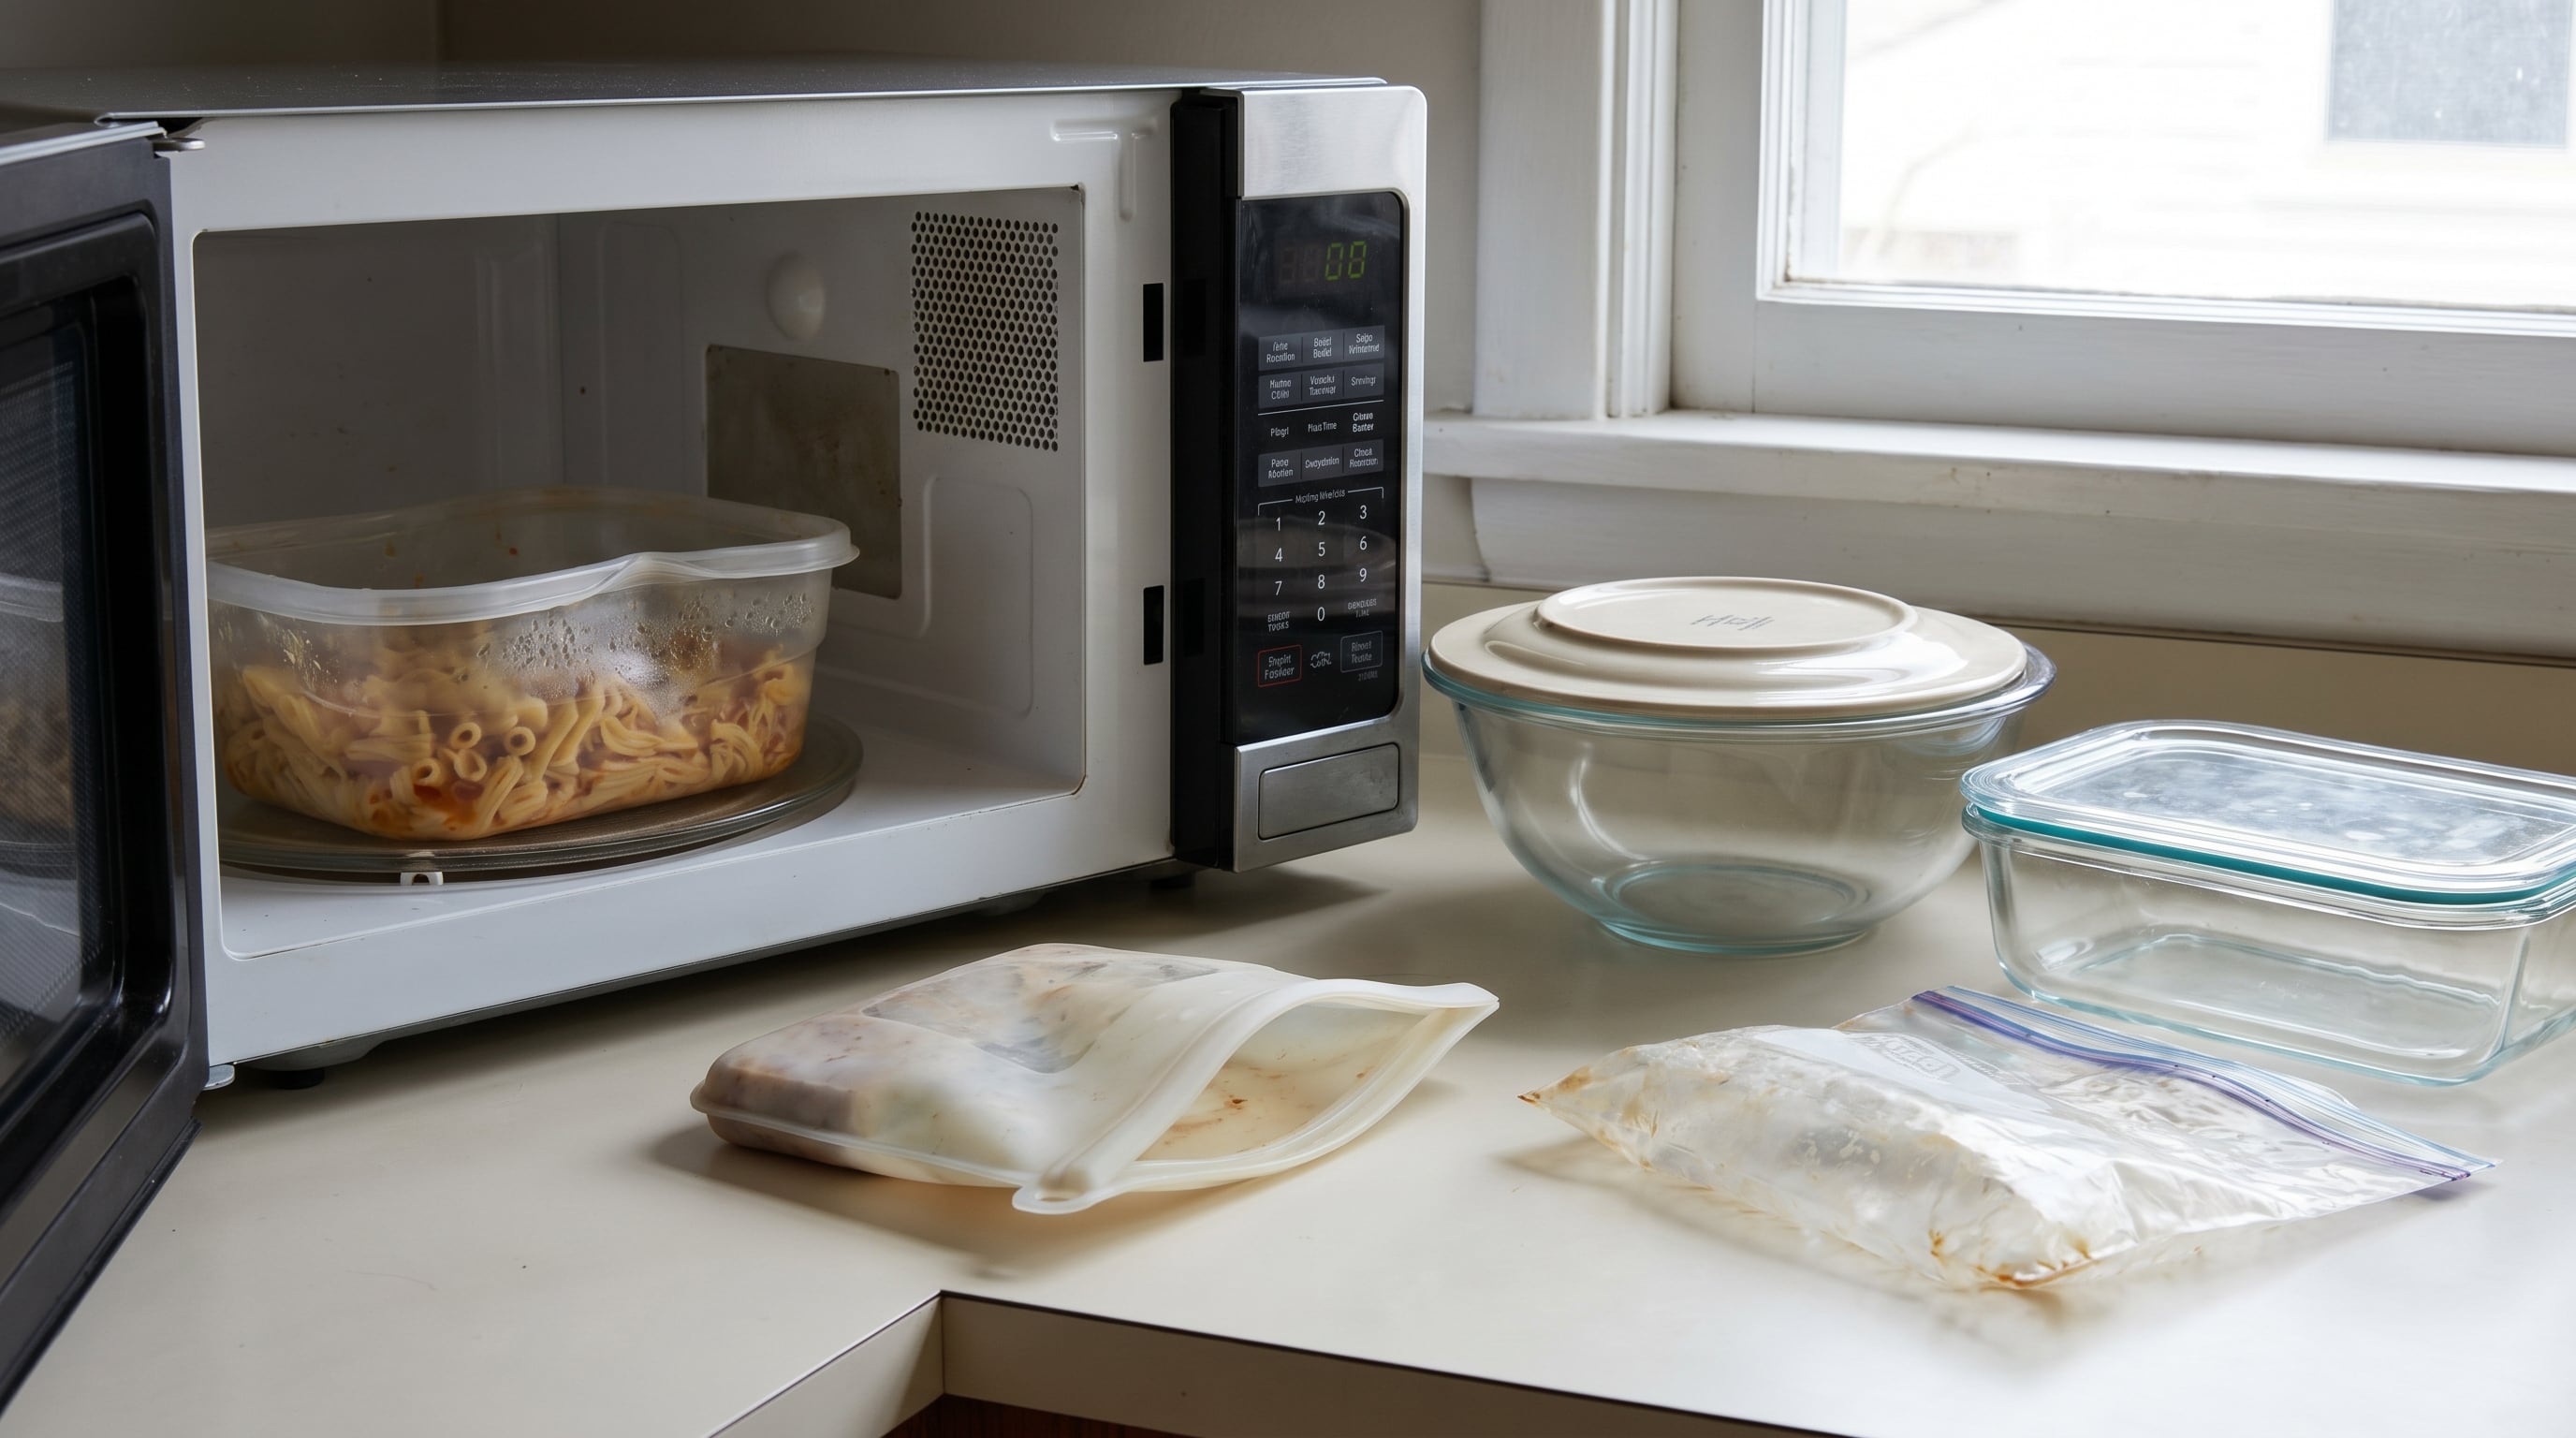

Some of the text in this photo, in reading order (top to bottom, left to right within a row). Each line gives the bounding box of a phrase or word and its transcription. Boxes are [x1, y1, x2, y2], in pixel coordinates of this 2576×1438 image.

[1276, 505, 1368, 532] 1 2 3
[1275, 536, 1368, 563] 4 5 6
[1275, 567, 1368, 596] 7 8 9
[1317, 607, 1325, 622] 0
